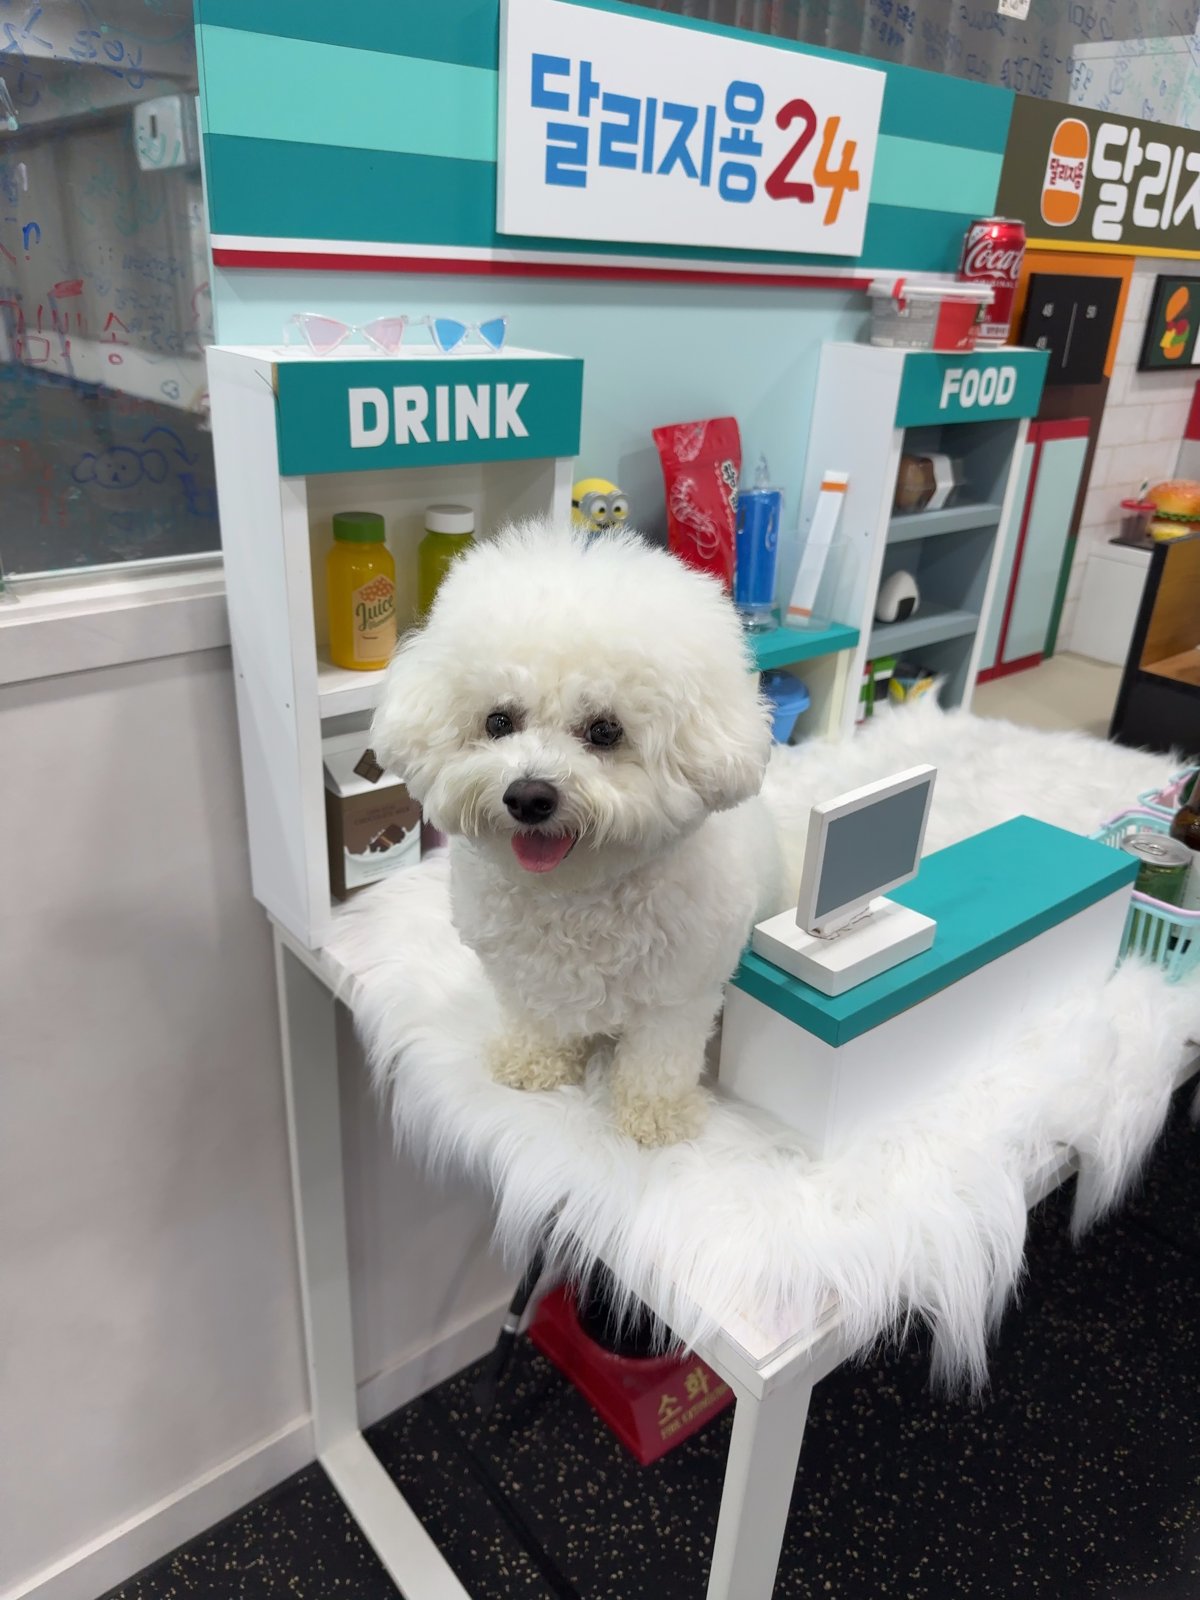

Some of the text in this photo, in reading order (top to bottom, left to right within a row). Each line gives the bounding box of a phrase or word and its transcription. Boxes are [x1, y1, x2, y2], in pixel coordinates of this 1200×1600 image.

[531, 52, 860, 226] 달리지용24
[938, 366, 1017, 409] FOOD
[347, 383, 530, 448] DRINK
[356, 595, 394, 632] Juice
